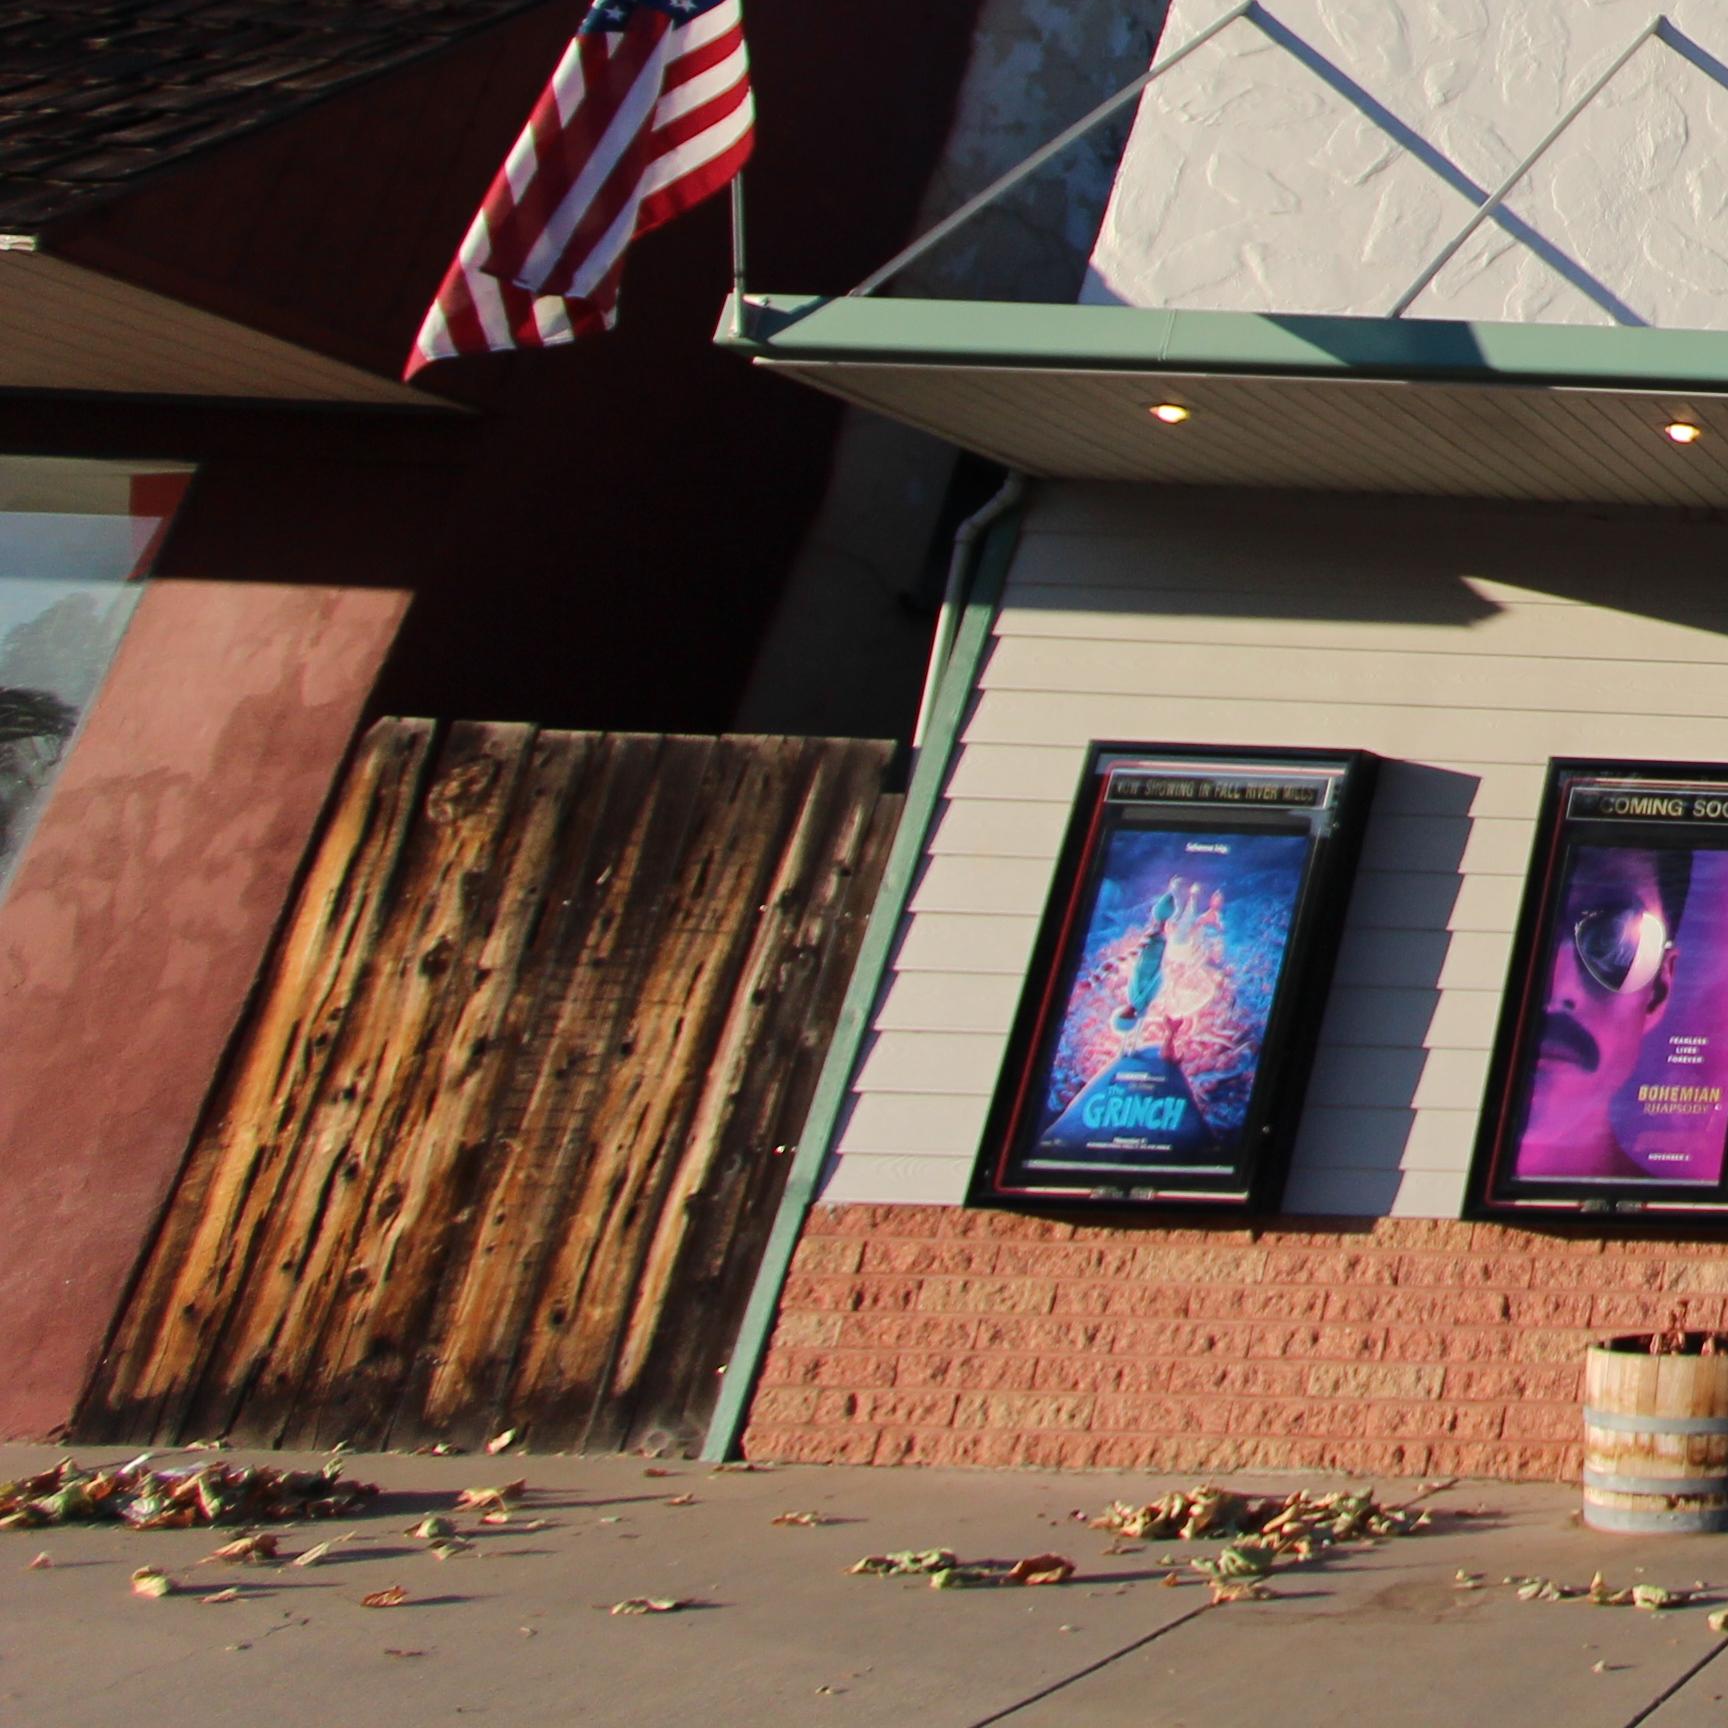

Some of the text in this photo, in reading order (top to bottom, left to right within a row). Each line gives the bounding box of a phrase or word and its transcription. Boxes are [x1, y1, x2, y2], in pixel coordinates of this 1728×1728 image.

[1145, 780, 1194, 797] SHOWING
[1199, 781, 1210, 797] IN
[1213, 782, 1241, 799] FALL
[1245, 783, 1278, 800] RIVER
[1600, 796, 1683, 817] COMING
[1669, 1036, 1708, 1045] FEARLESS
[1675, 1046, 1697, 1054] LIVES
[1638, 1085, 1721, 1103] BOHEMIAN
[1082, 1093, 1188, 1130] GRINCH
[1643, 1103, 1709, 1114] RHAPSODY
